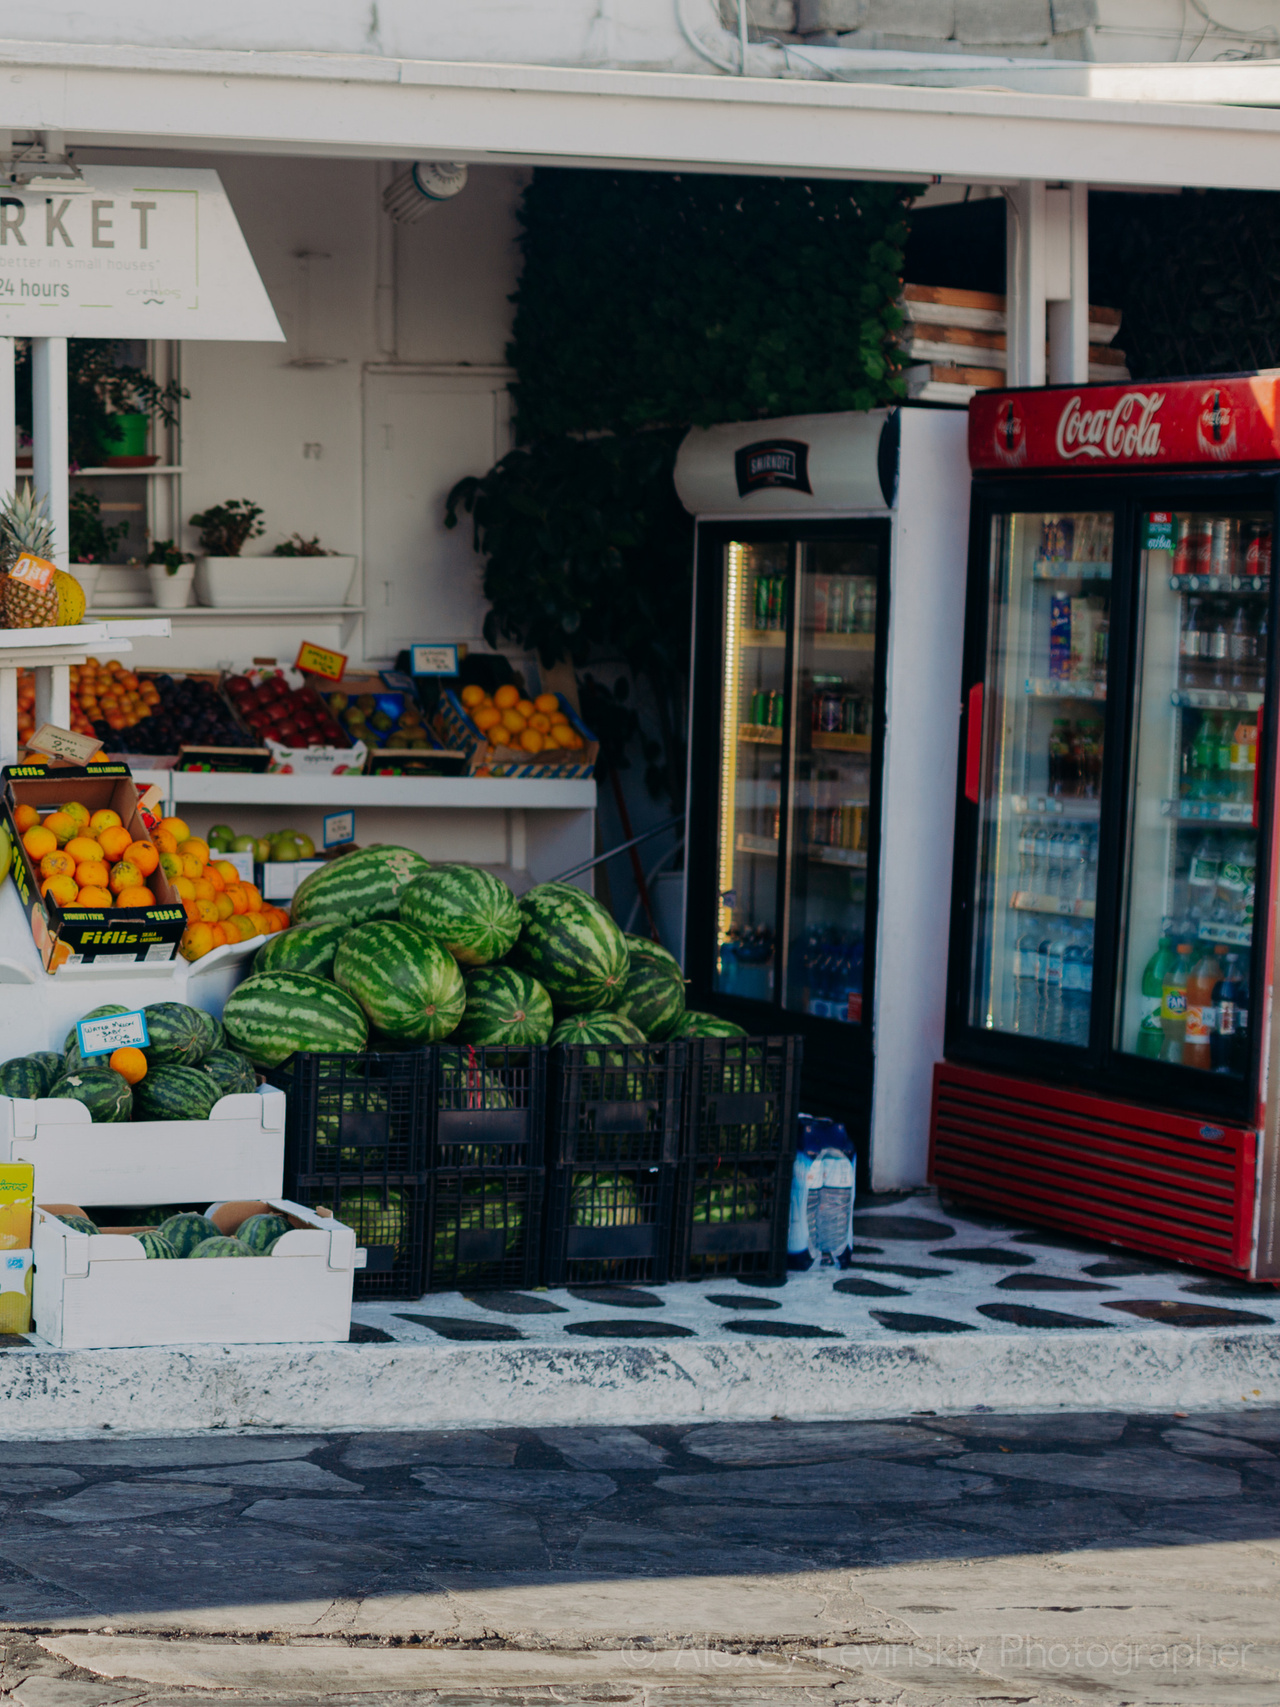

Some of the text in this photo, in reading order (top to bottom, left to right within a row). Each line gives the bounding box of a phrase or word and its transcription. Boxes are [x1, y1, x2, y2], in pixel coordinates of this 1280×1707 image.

[0, 255, 42, 268] better
[49, 257, 61, 268] in
[67, 257, 102, 269] small
[20, 278, 70, 297] hours
[1055, 391, 1167, 459] Coca-Cola
[751, 454, 790, 474] SMIRNOFF
[8, 767, 46, 777] Fiflis
[146, 909, 183, 921] Fiflis
[80, 930, 138, 944] Fiflis
[85, 1025, 109, 1033] WATER
